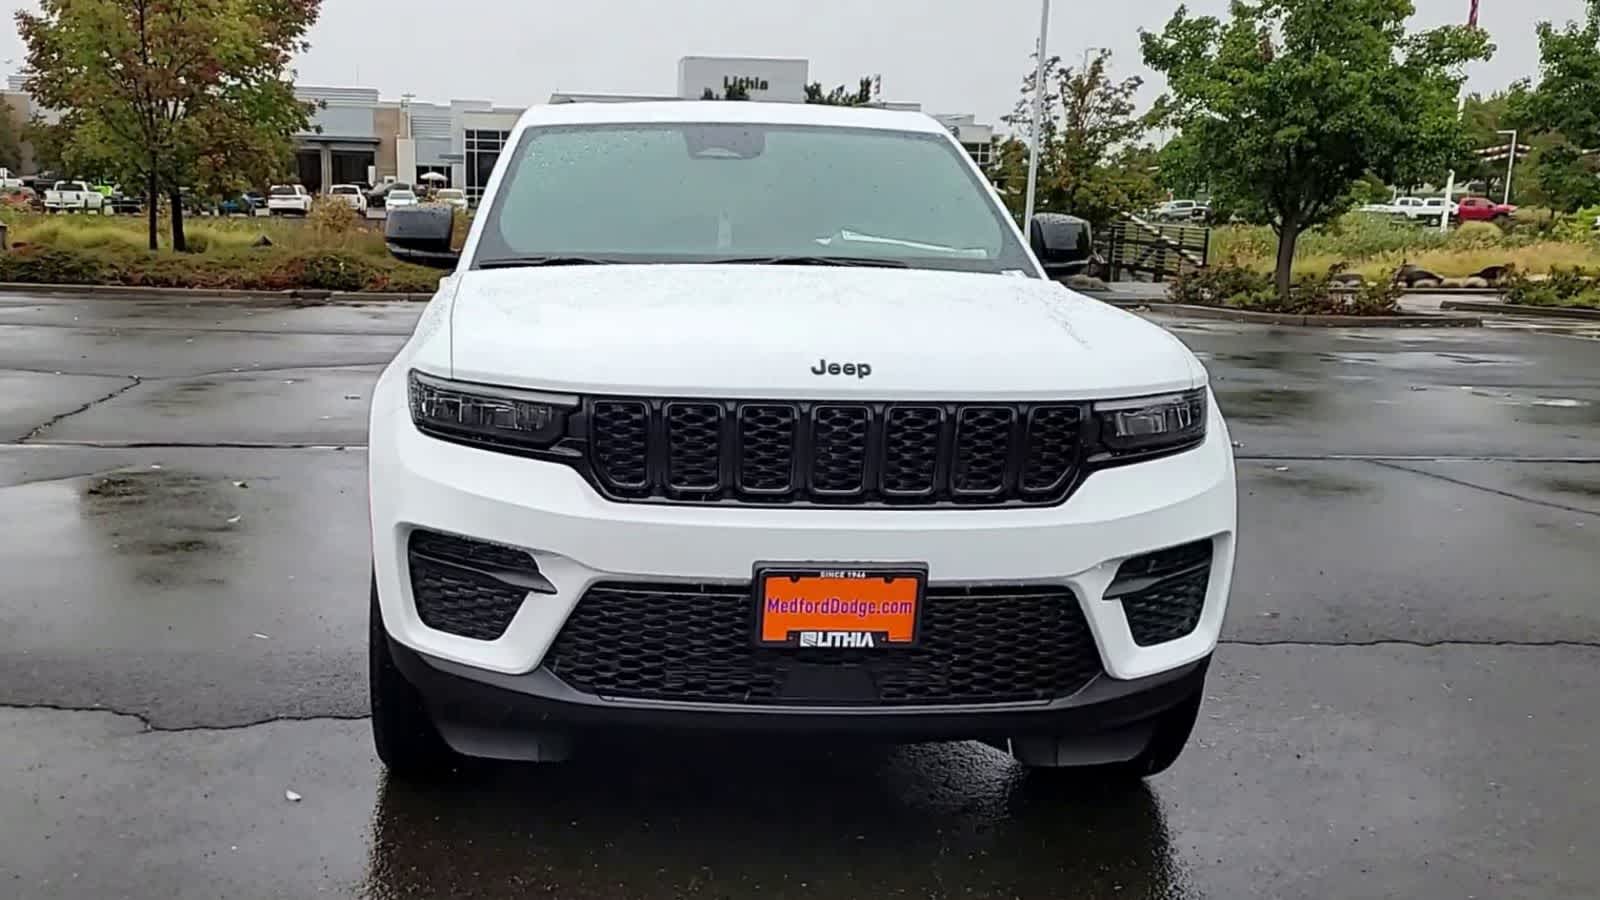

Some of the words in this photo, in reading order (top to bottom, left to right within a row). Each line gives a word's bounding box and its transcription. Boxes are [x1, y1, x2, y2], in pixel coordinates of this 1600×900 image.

[811, 359, 872, 379] Jeep
[820, 570, 844, 579] SINCE
[767, 597, 913, 618] MedfordDodge.com
